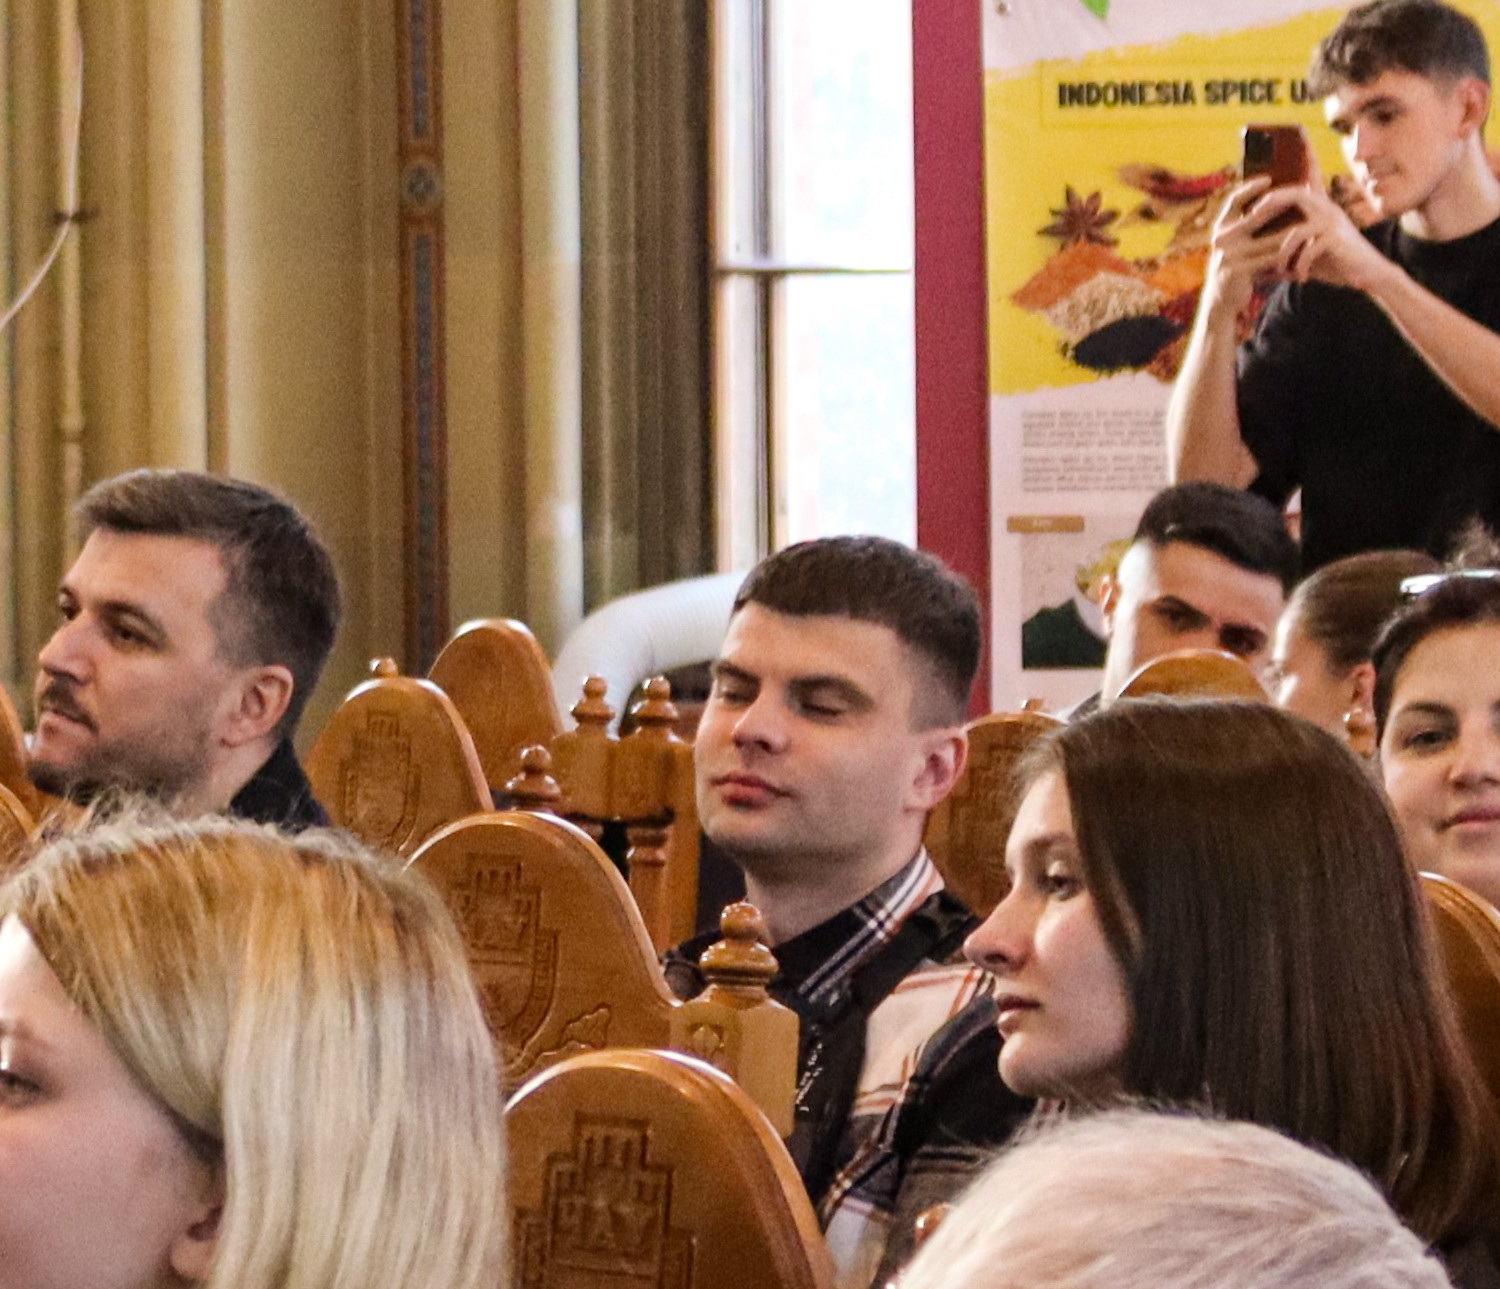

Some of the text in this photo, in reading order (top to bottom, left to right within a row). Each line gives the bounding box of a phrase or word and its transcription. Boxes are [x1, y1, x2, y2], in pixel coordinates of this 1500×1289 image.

[1058, 78, 1317, 107] INDONESIA SPICE U
